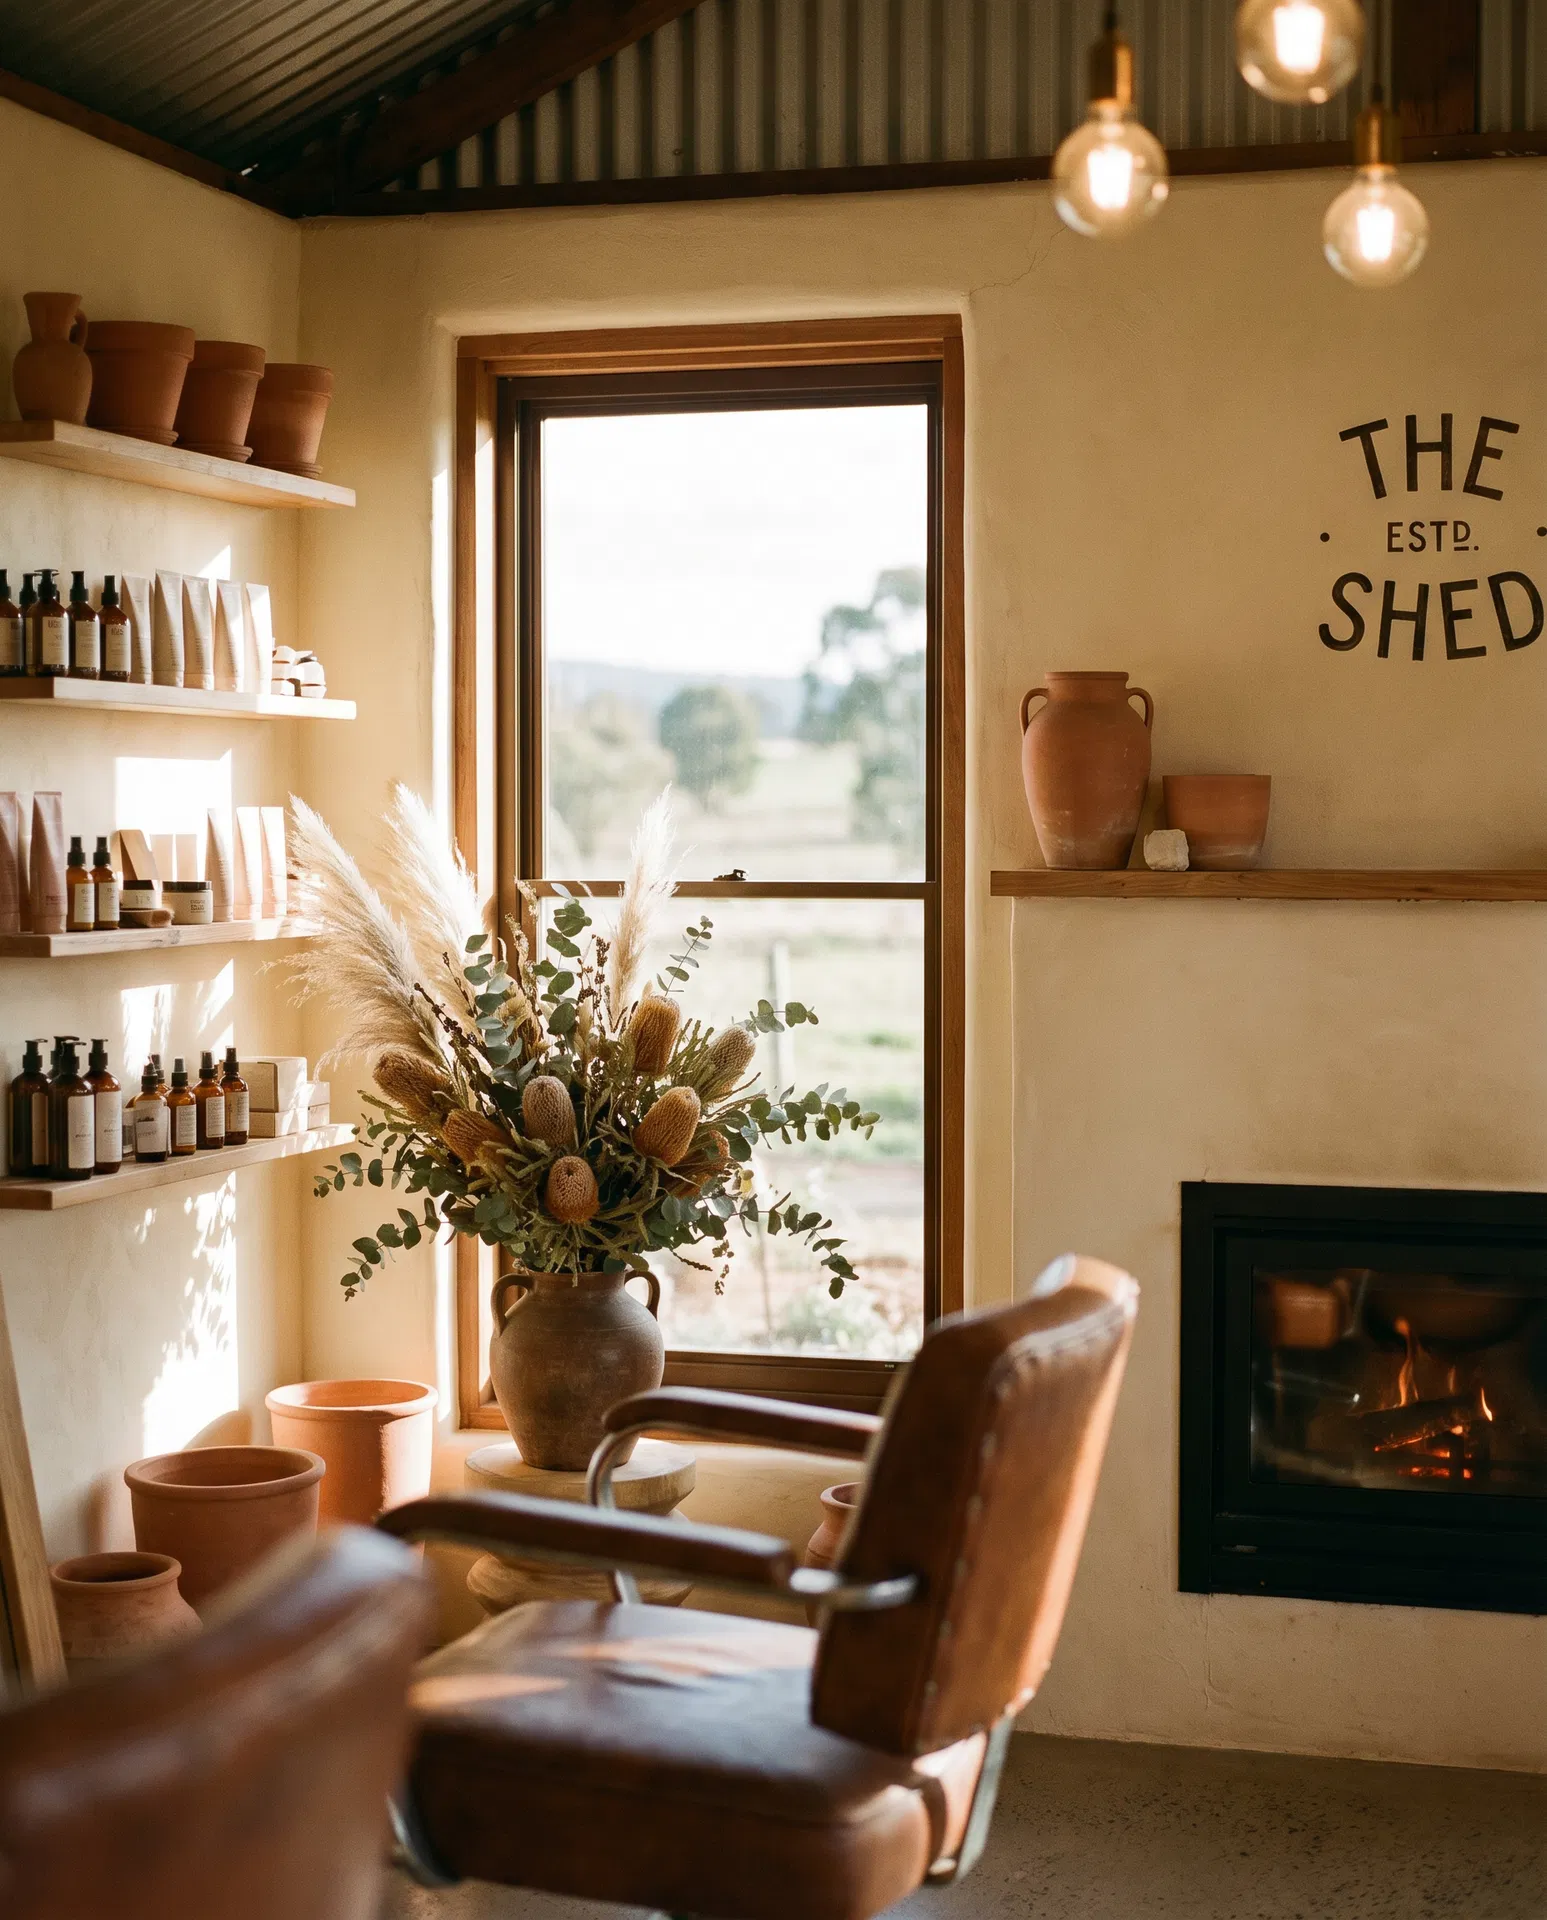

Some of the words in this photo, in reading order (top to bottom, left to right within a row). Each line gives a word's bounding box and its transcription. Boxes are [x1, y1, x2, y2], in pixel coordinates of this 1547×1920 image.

[1339, 413, 1520, 501] THE
[1387, 520, 1480, 553] ESTD.
[1318, 571, 1544, 661] SHED
